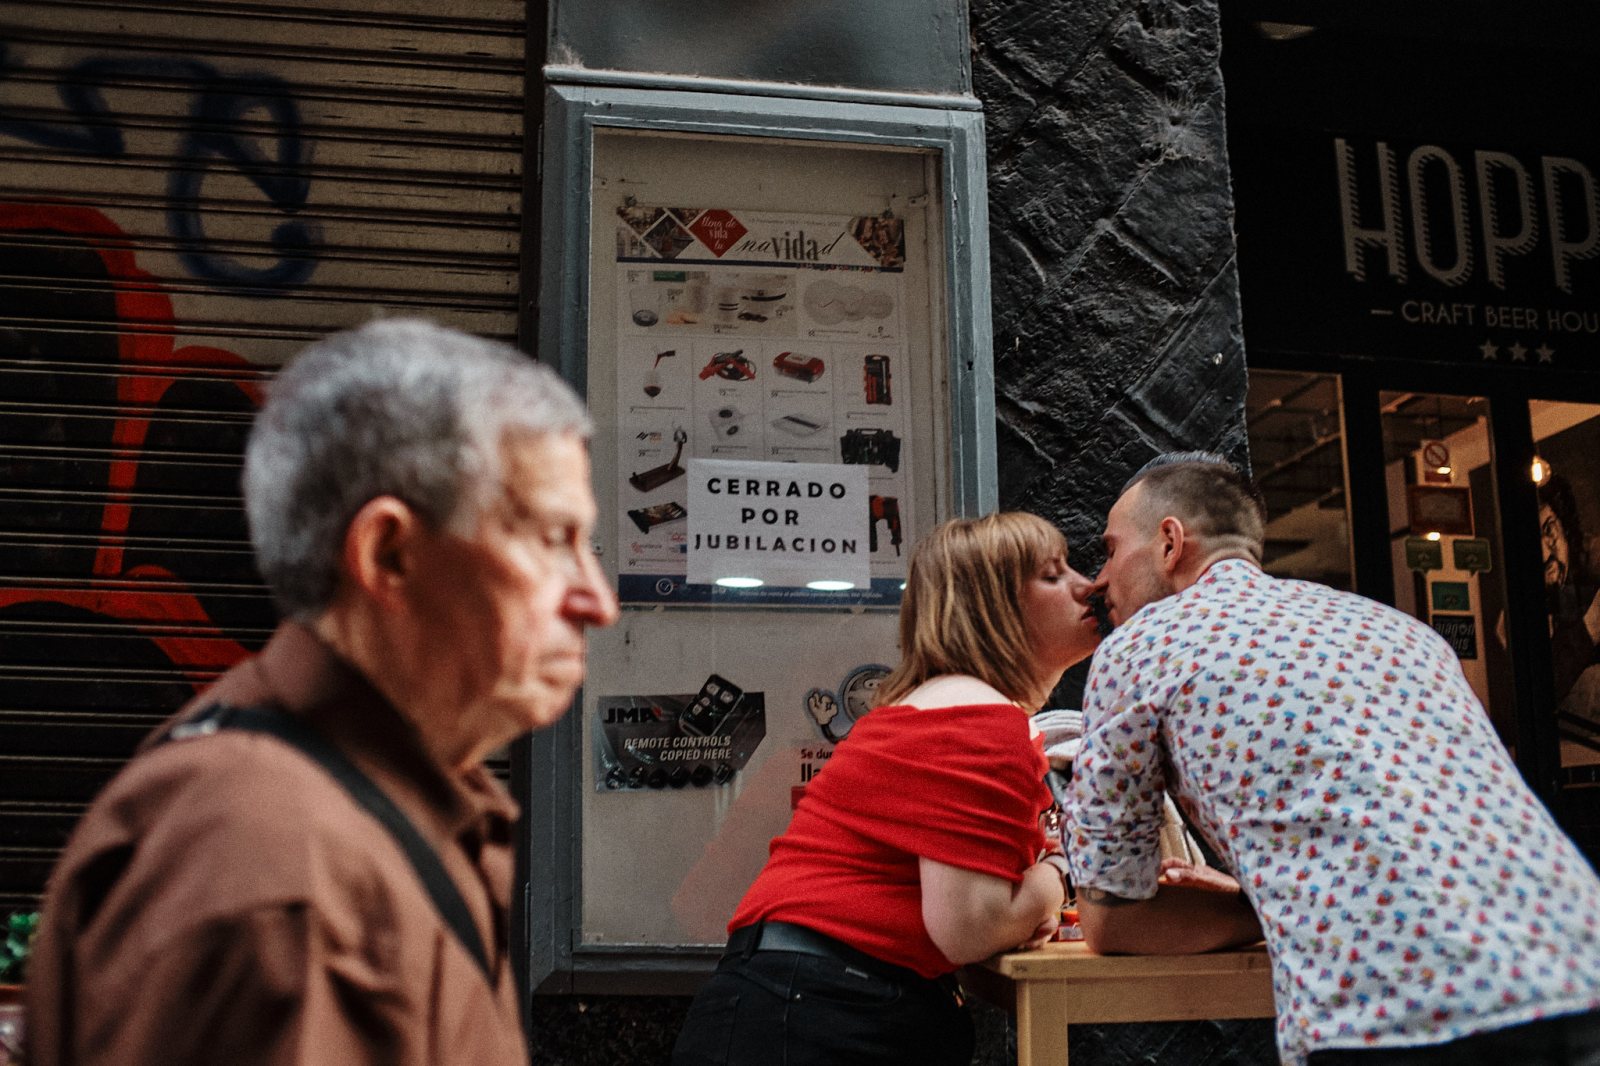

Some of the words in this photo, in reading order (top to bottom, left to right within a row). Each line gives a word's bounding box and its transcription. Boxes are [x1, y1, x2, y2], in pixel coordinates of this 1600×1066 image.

[708, 228, 728, 239] vida
[735, 231, 846, 261] navidad
[1401, 300, 1475, 325] CRAFT
[1485, 306, 1539, 330] BEER
[707, 477, 847, 499] CERRADO
[741, 507, 800, 525] POR
[695, 534, 857, 554] JUBILACION
[603, 707, 658, 724] JMA
[624, 737, 669, 750] REMOTE
[673, 735, 732, 748] CONTROLS
[659, 749, 700, 761] COPIED
[703, 748, 732, 760] HERE
[801, 748, 813, 759] Se
